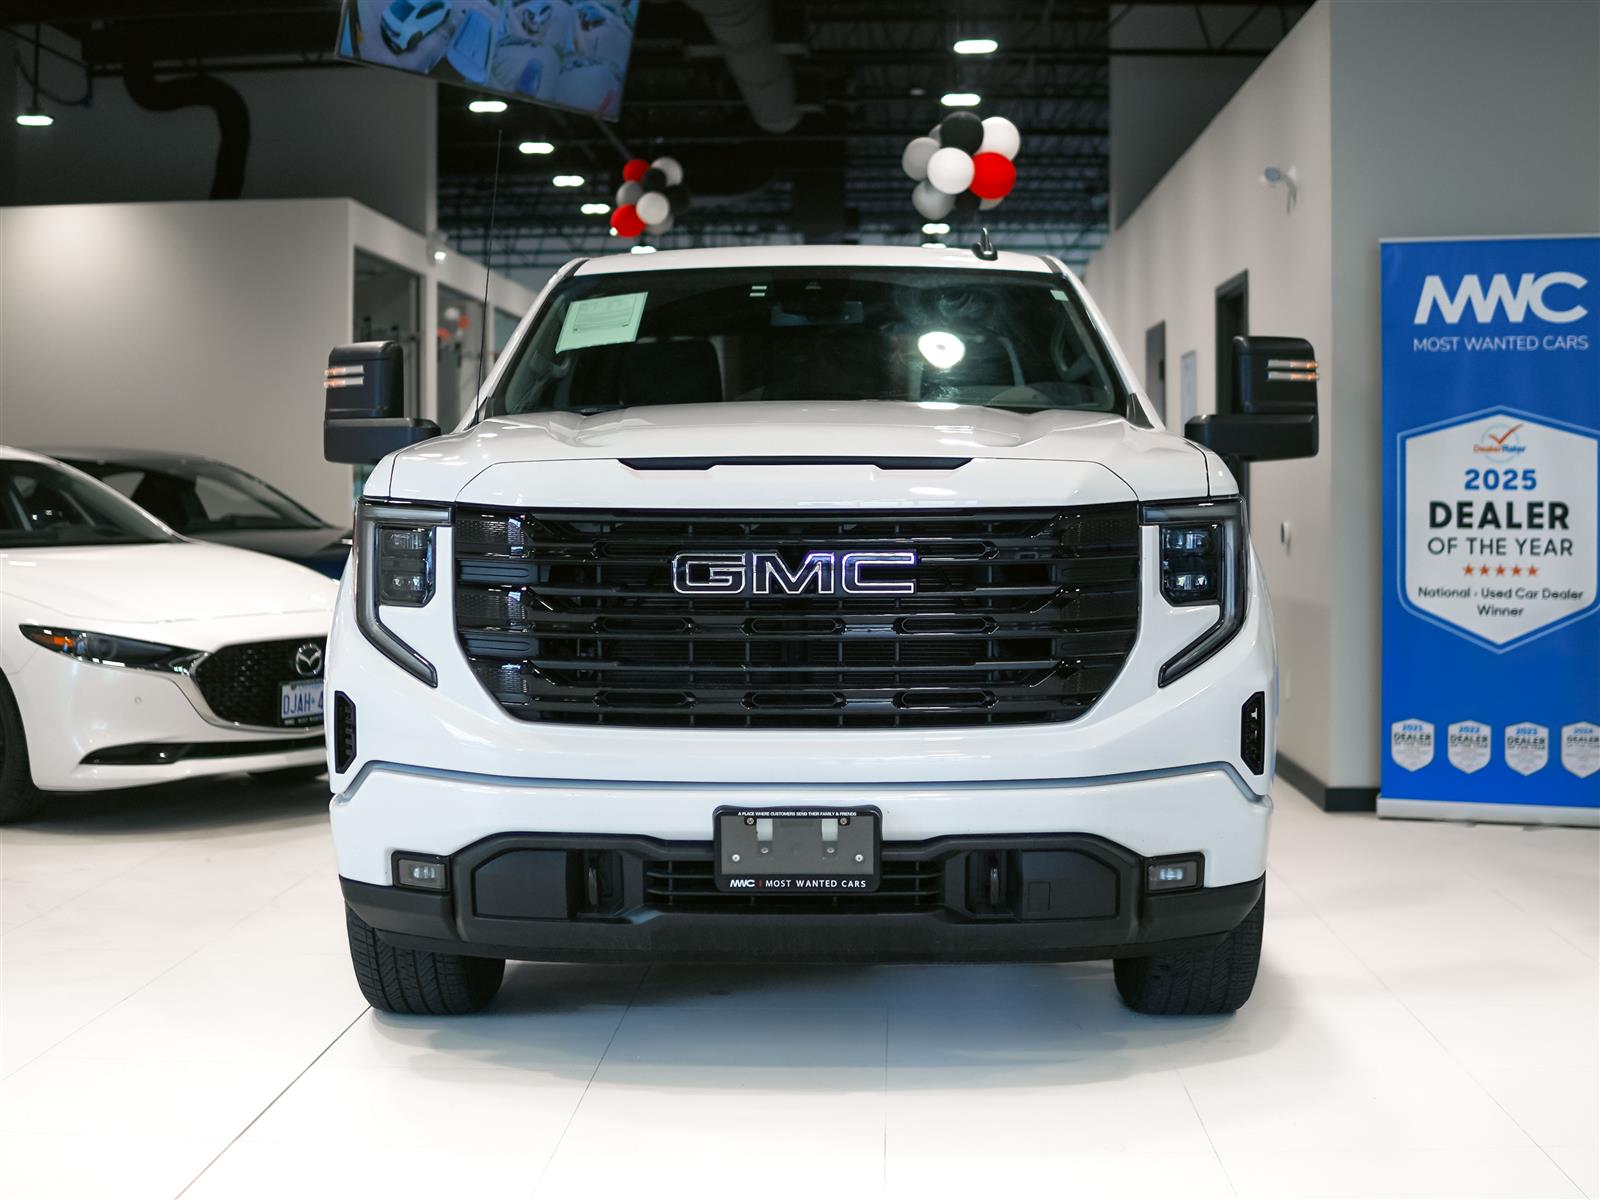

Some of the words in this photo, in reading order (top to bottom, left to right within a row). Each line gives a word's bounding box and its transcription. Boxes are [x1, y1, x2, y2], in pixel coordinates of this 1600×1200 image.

[1413, 271, 1588, 324] MWC
[1413, 337, 1460, 352] MOST
[1464, 336, 1539, 351] WANTED
[1543, 335, 1589, 350] CARS
[1464, 468, 1537, 490] 2025
[1429, 501, 1569, 530] DEALER
[1427, 537, 1458, 556] OF
[1466, 537, 1507, 556] THE
[1515, 538, 1573, 556] YEAR
[672, 552, 916, 594] GMC
[1418, 586, 1471, 599] National
[1481, 587, 1512, 600] Used
[1515, 588, 1537, 600] Car
[1541, 588, 1583, 600] Dealer
[1477, 604, 1524, 616] Winner
[1393, 732, 1432, 742] DEALER
[1450, 734, 1489, 743] DEALER
[1507, 736, 1546, 746] DEALER
[1567, 735, 1600, 744] DEALER
[729, 879, 756, 888] MWC
[765, 879, 791, 888] MOST
[796, 879, 838, 888] WANTED
[841, 880, 866, 888] CARS
